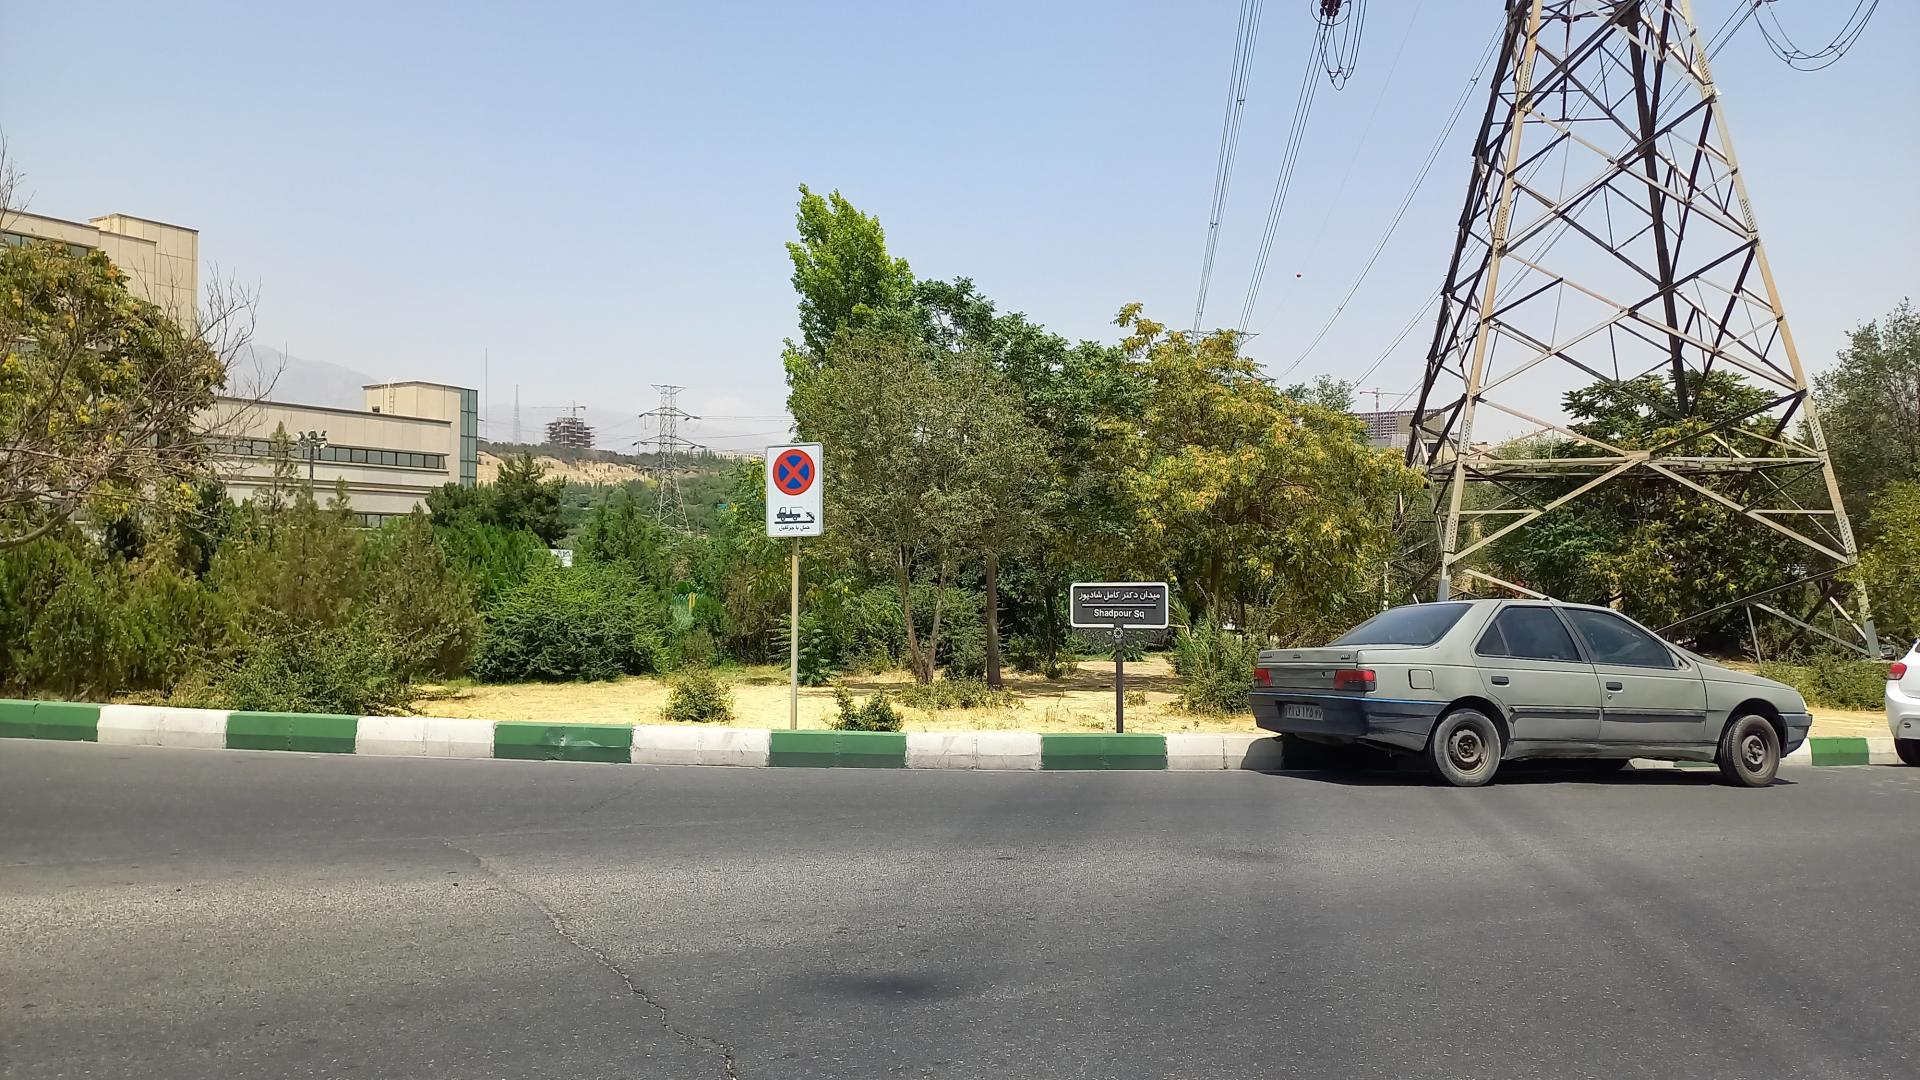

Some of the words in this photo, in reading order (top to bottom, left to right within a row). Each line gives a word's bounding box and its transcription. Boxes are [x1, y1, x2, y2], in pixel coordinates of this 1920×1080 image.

[1079, 591, 1102, 601] شادپور
[1103, 591, 1120, 601] کامل
[1121, 591, 1138, 601] دکتر
[1140, 591, 1160, 601] میدان
[1093, 609, 1132, 618] Shadpour
[1134, 609, 1145, 619] Sq
